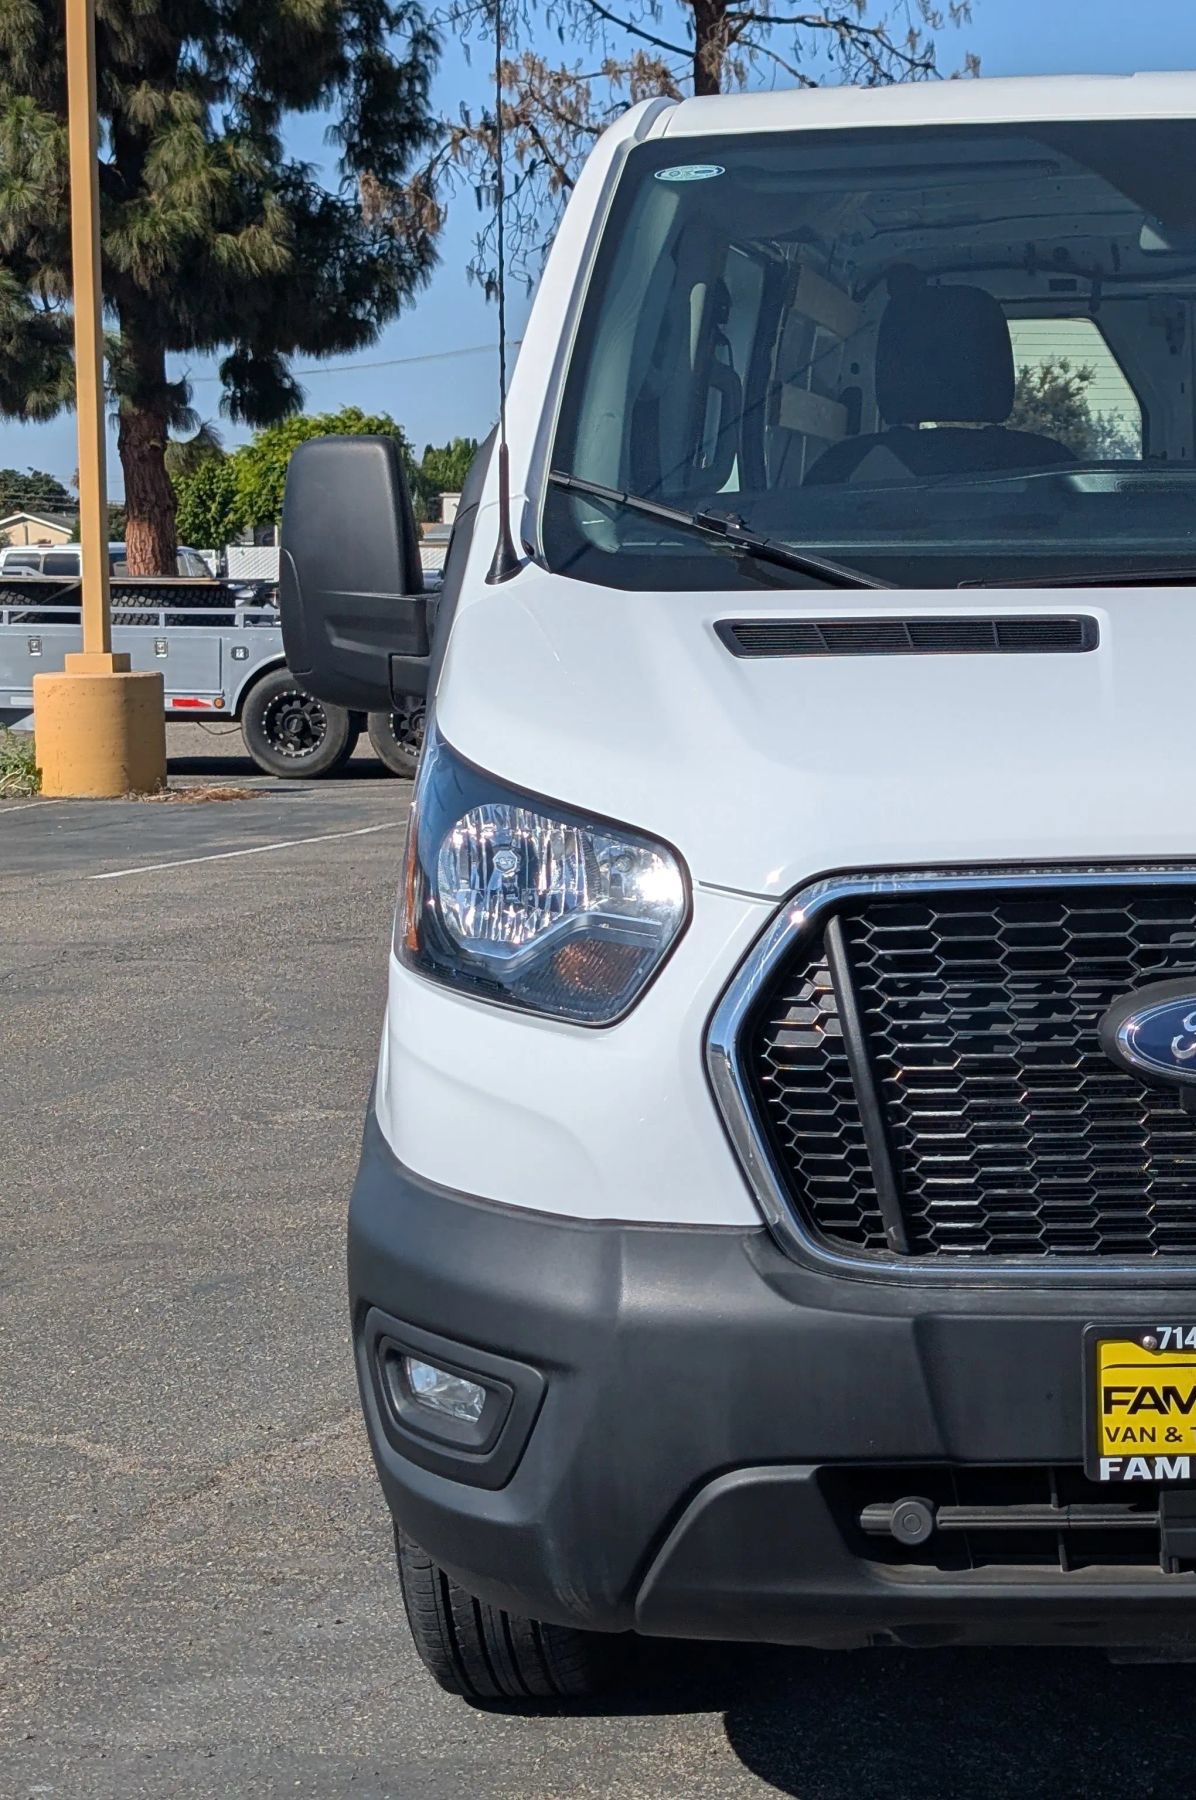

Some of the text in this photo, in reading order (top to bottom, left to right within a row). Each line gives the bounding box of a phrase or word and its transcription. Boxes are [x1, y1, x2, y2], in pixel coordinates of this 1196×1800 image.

[1105, 1426, 1156, 1443] VAN
[1164, 1426, 1183, 1443] &
[1099, 1456, 1190, 1481] FAM
